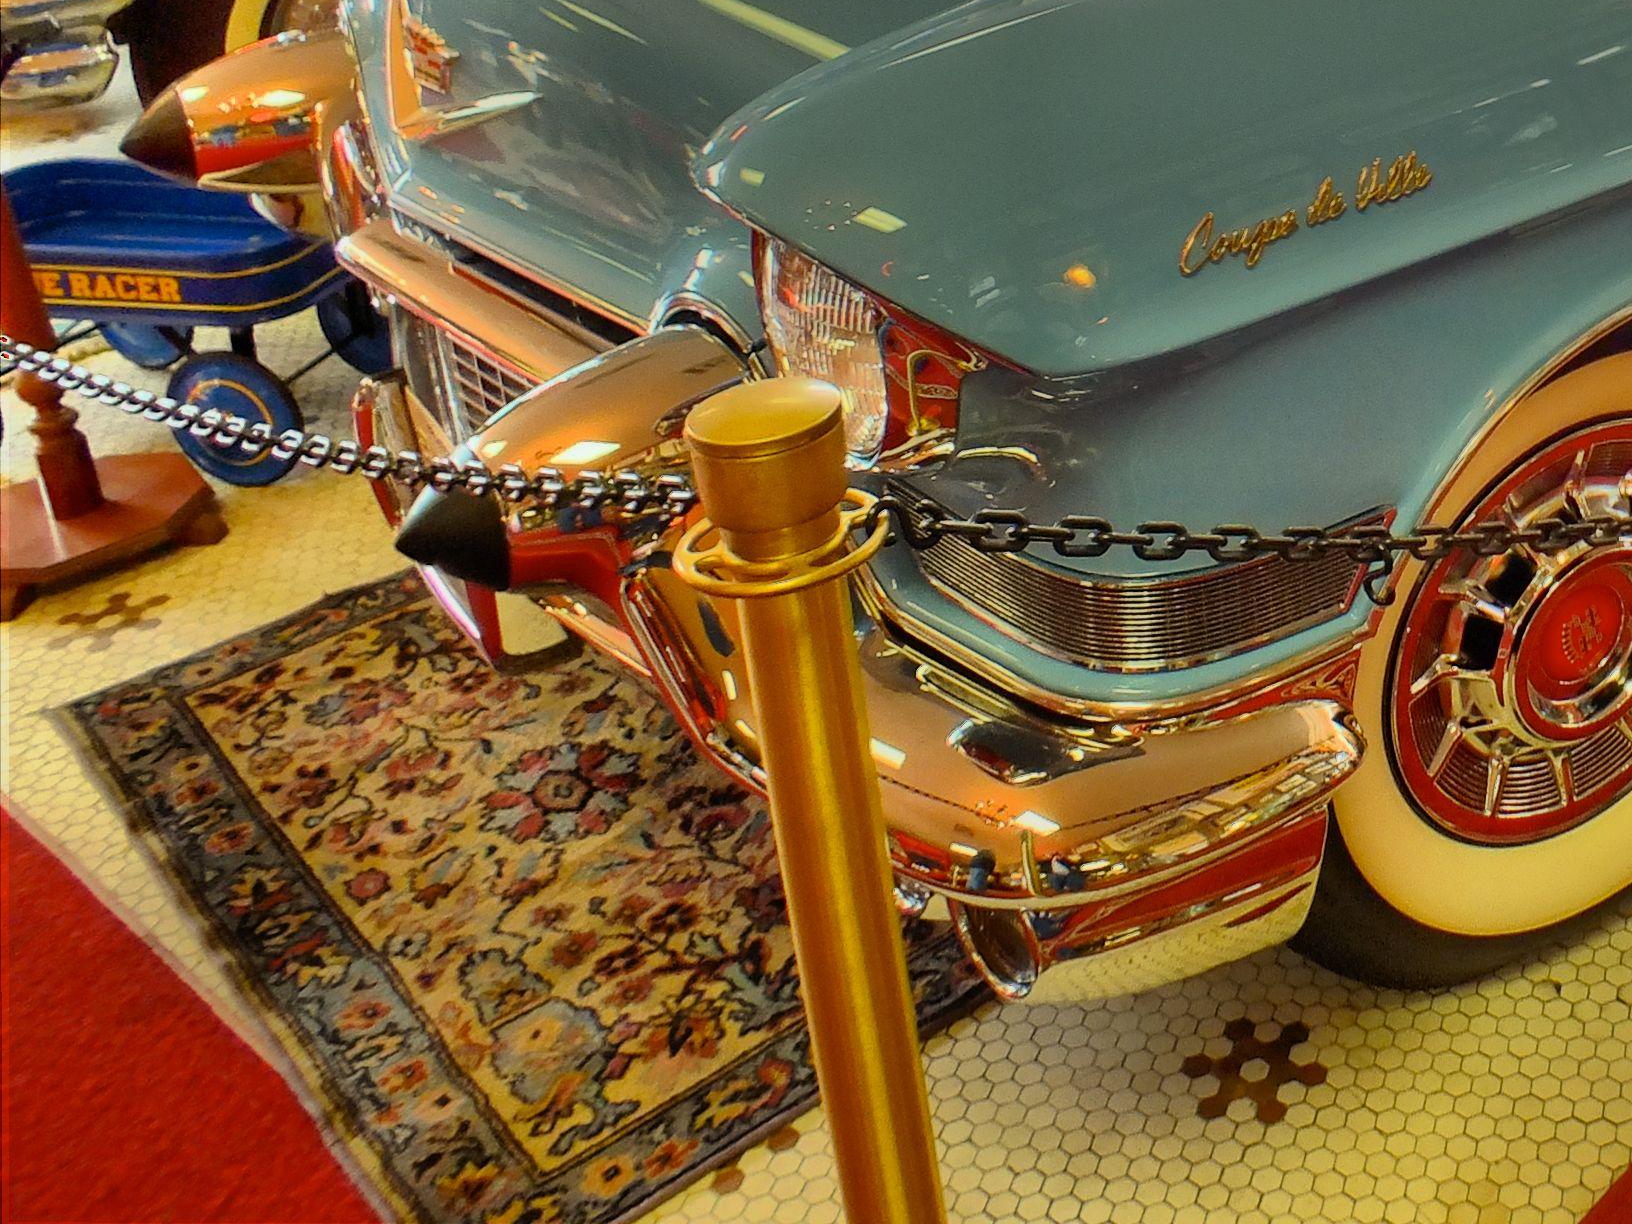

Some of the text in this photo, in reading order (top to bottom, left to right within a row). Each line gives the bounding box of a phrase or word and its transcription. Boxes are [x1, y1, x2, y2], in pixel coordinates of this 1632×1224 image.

[1178, 150, 1433, 278] Coupe de Ville
[67, 272, 182, 303] RACER
